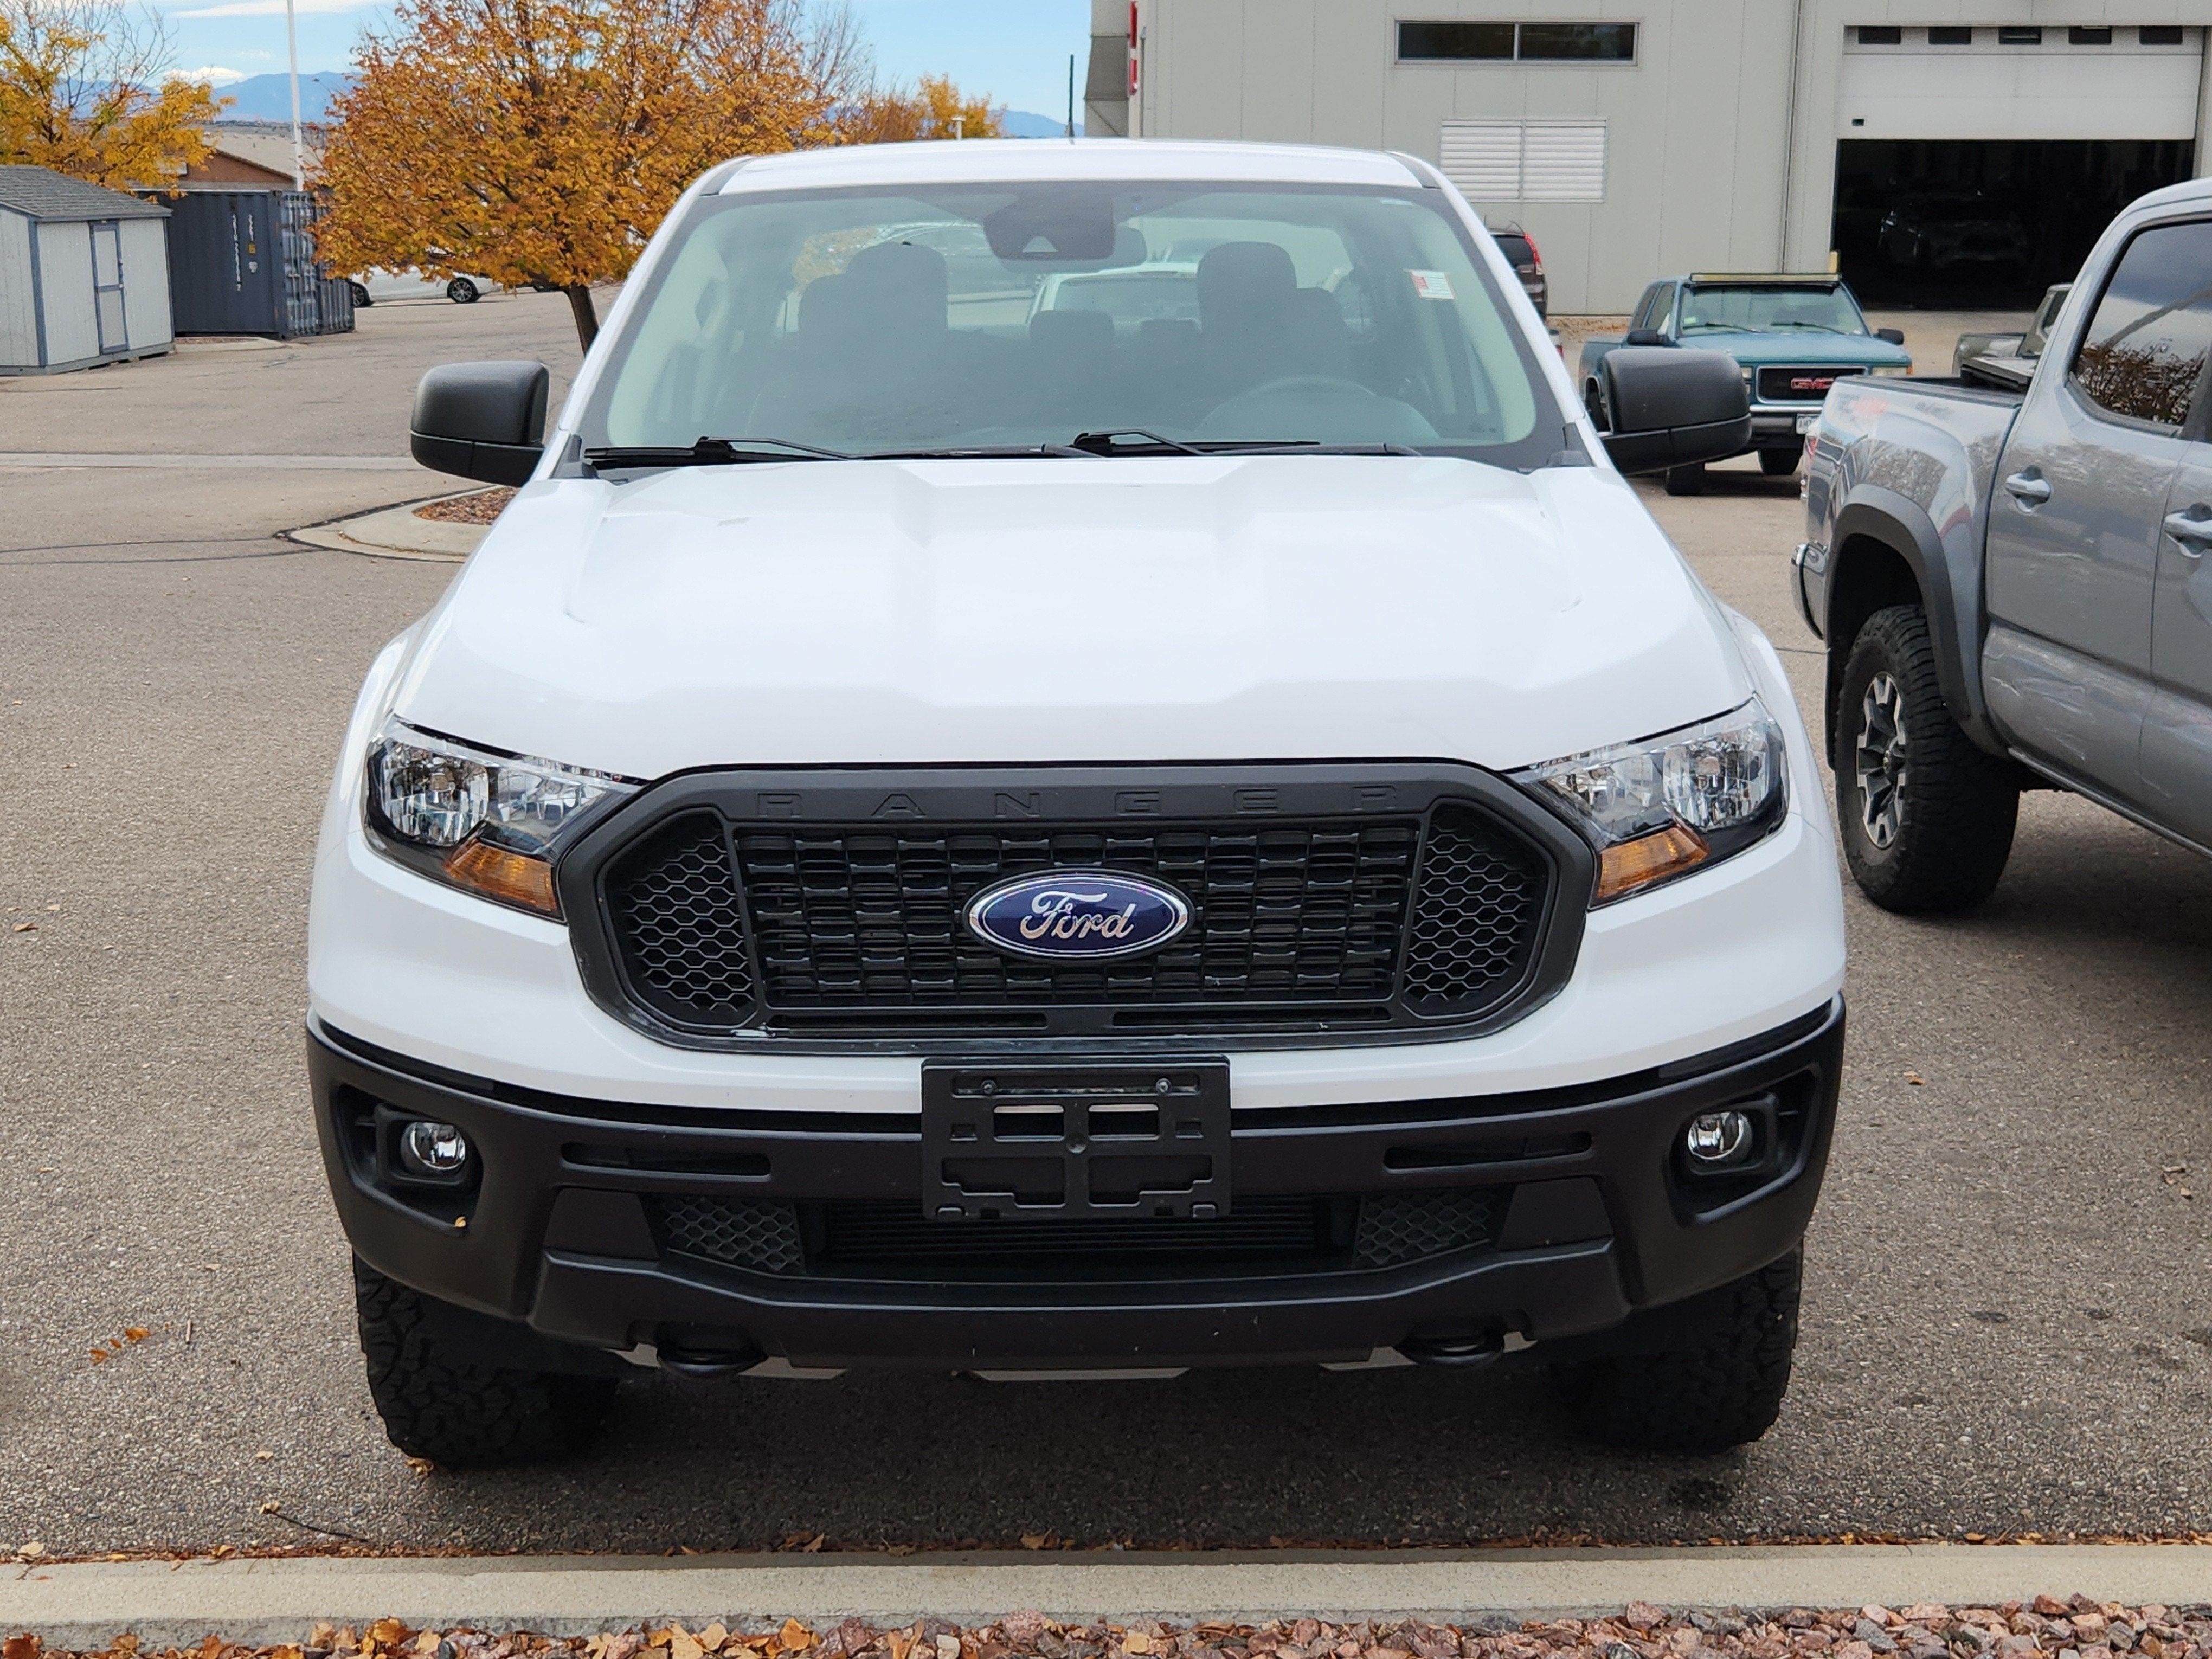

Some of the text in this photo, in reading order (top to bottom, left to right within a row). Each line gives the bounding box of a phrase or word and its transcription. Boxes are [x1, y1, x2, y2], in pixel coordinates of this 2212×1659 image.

[1791, 377, 1835, 390] GMC
[757, 785, 1397, 819] RANGER
[1019, 890, 1137, 939] Ford
